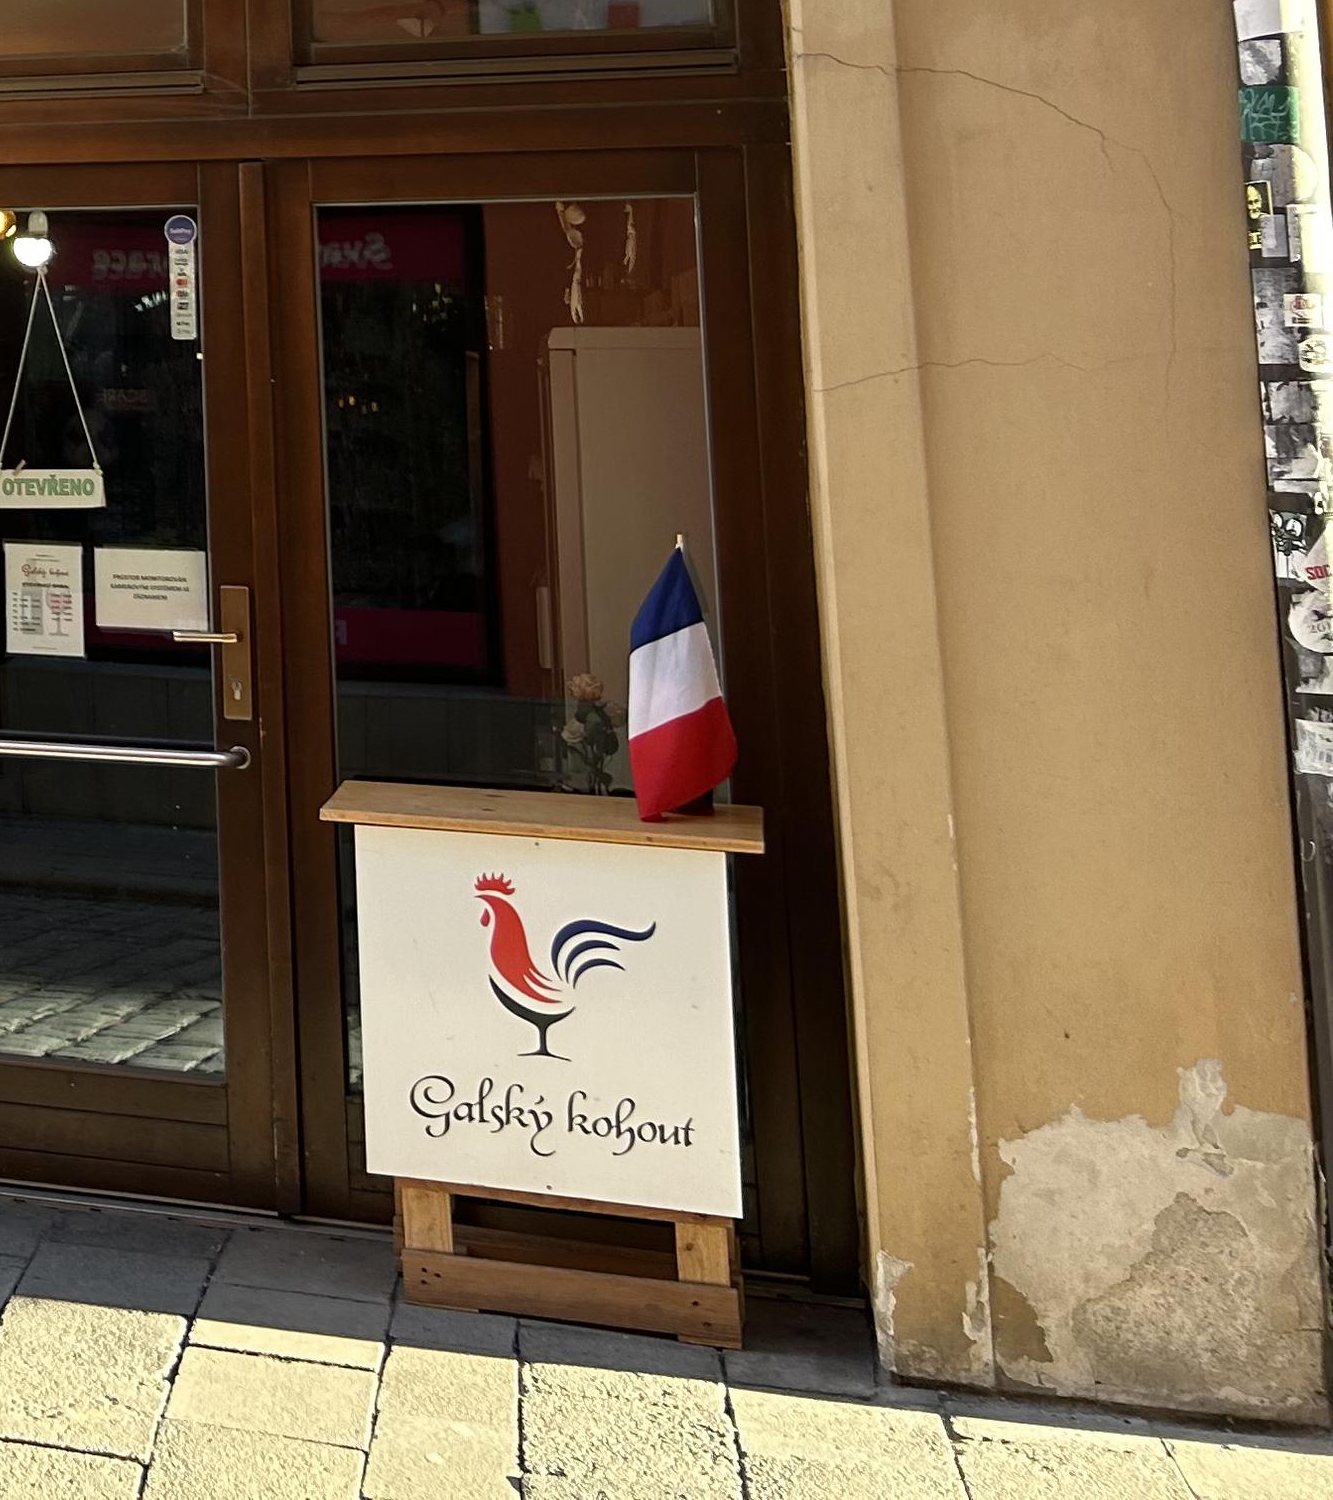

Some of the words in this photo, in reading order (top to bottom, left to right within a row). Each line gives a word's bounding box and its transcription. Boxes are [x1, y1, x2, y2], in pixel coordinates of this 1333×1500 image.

[2, 474, 95, 496] OTEVŘENO
[409, 1075, 556, 1157] Galský
[567, 1090, 695, 1156] kohout
